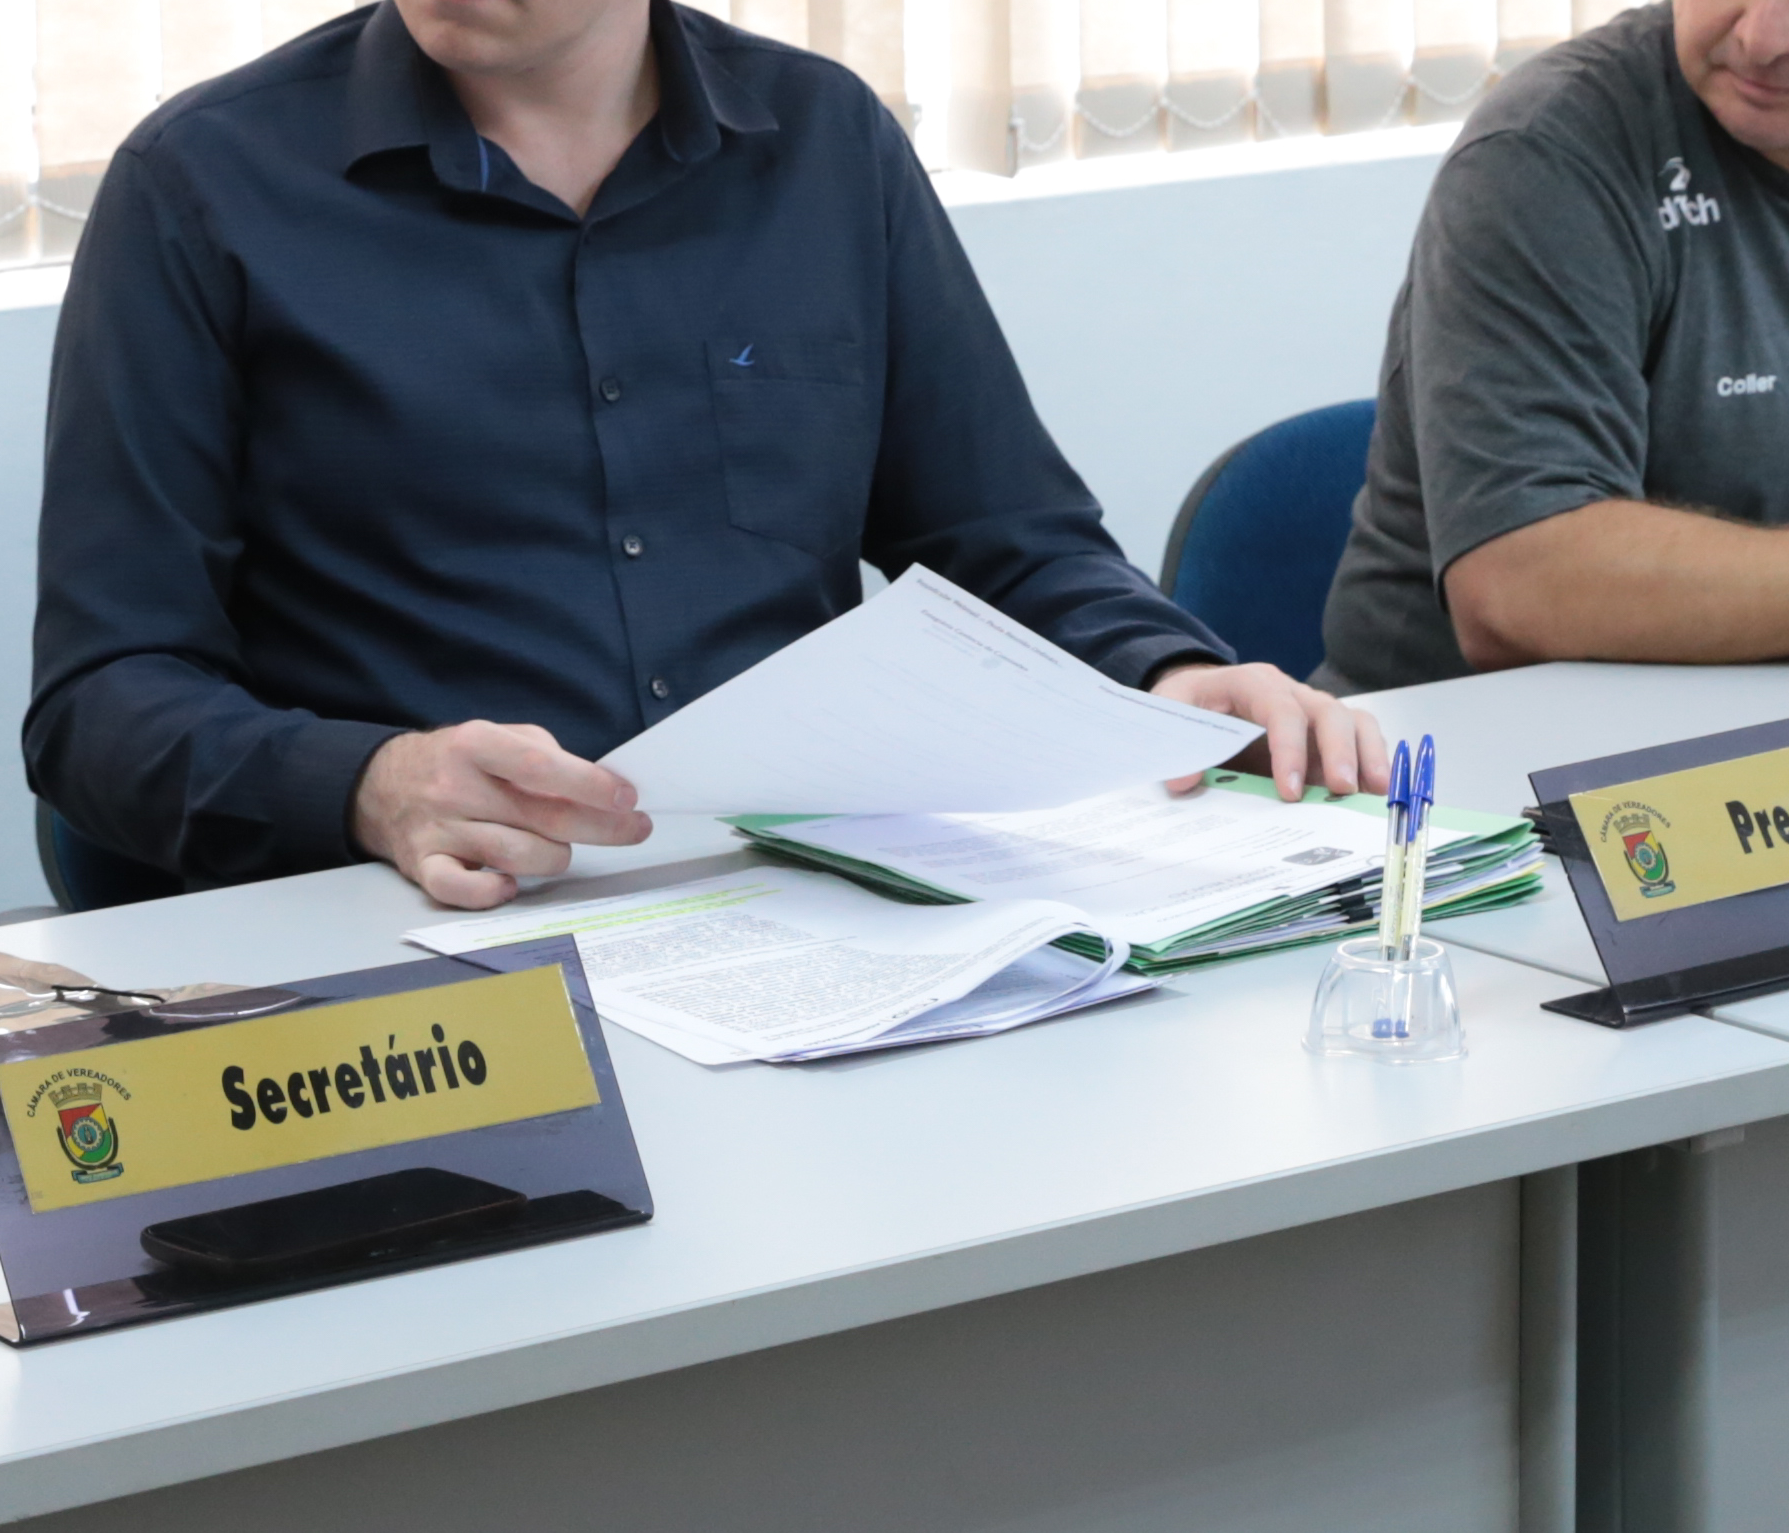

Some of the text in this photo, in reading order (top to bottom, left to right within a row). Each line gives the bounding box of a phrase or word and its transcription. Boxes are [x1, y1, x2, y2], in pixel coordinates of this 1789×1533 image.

[1716, 372, 1778, 397] Coller
[26, 1067, 132, 1118] CÂMARA DE VEREADORES
[221, 1023, 488, 1131] Secretário
